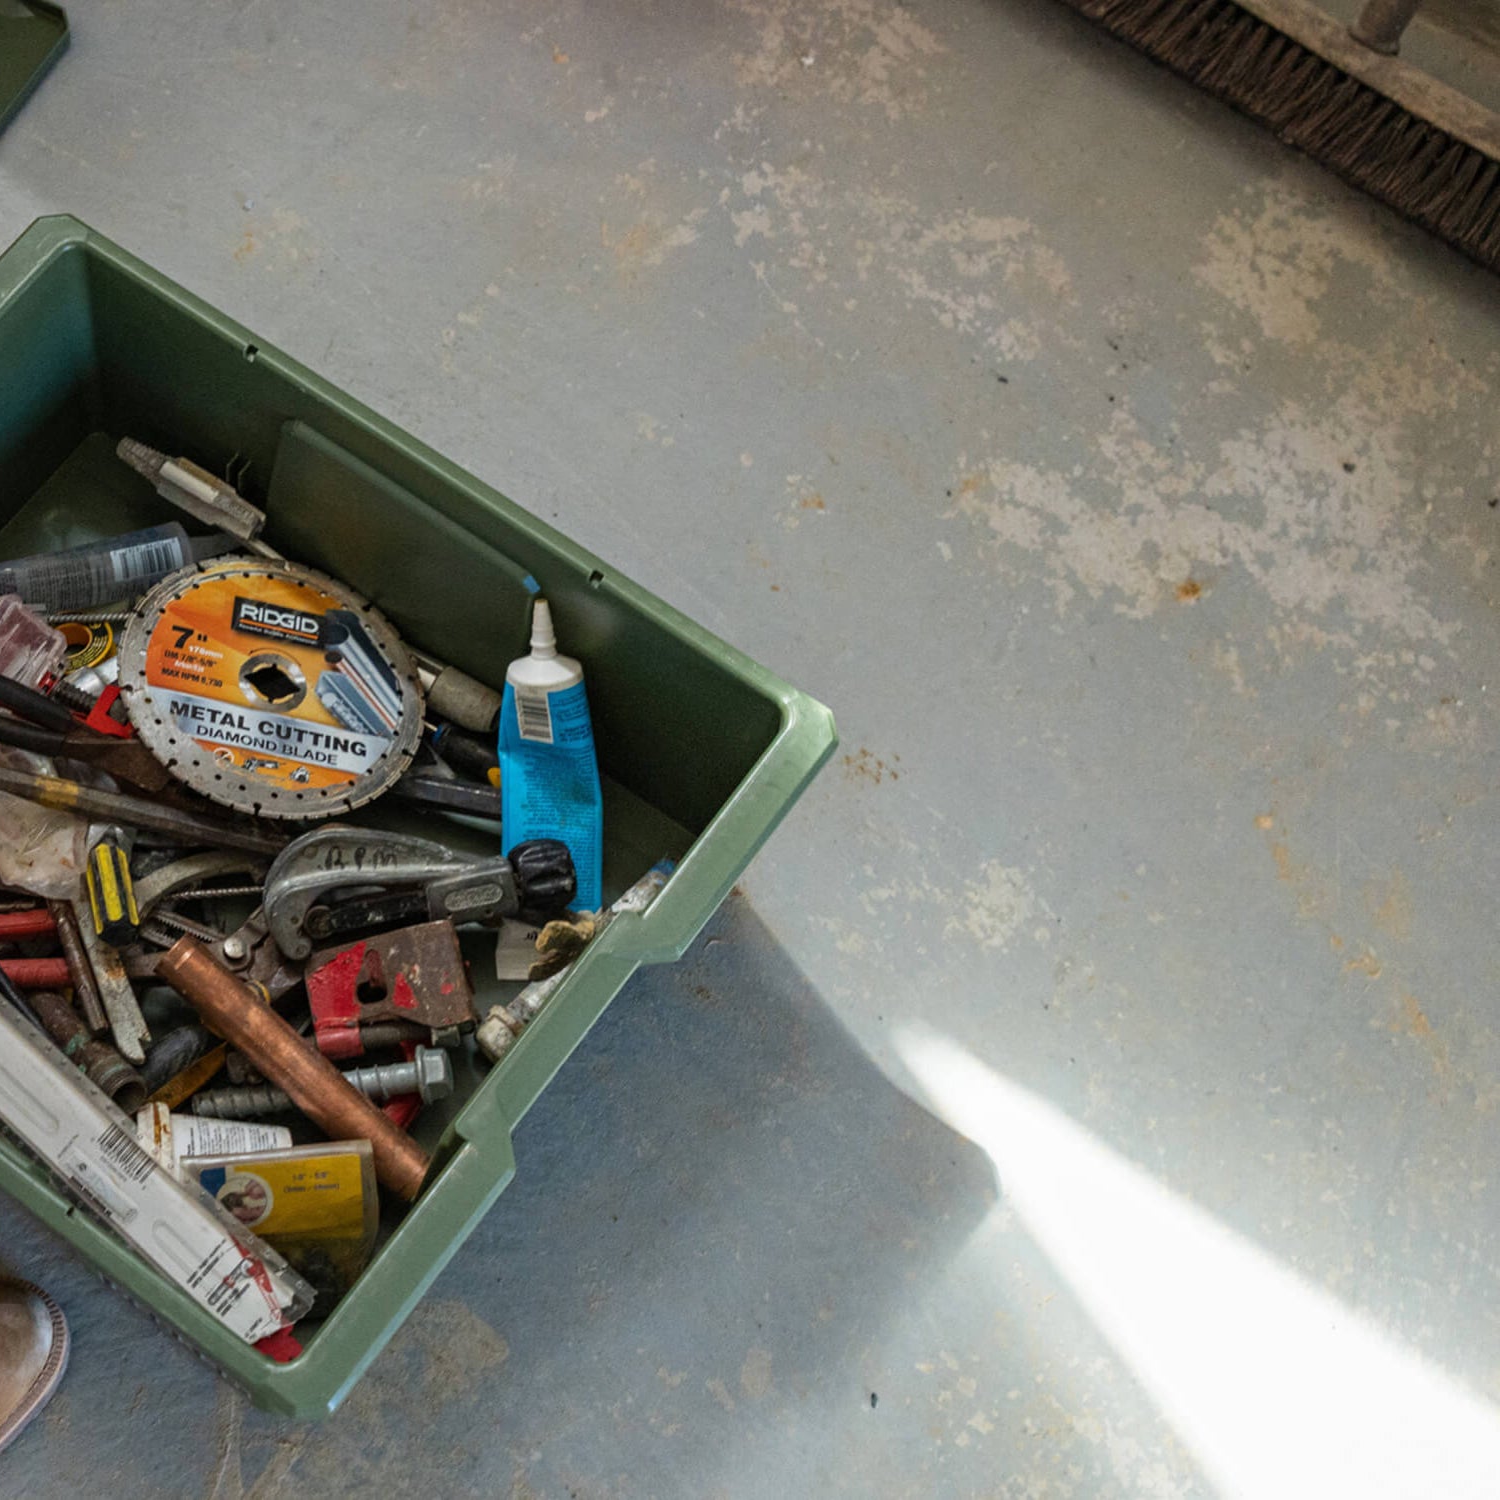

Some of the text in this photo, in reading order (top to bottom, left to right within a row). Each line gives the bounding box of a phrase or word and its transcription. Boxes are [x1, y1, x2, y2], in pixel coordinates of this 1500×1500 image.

[241, 604, 319, 633] RIDGID
[161, 667, 180, 678] MAX
[170, 700, 367, 757] METAL CUTTING
[196, 725, 338, 766] DIAMOND BLADE
